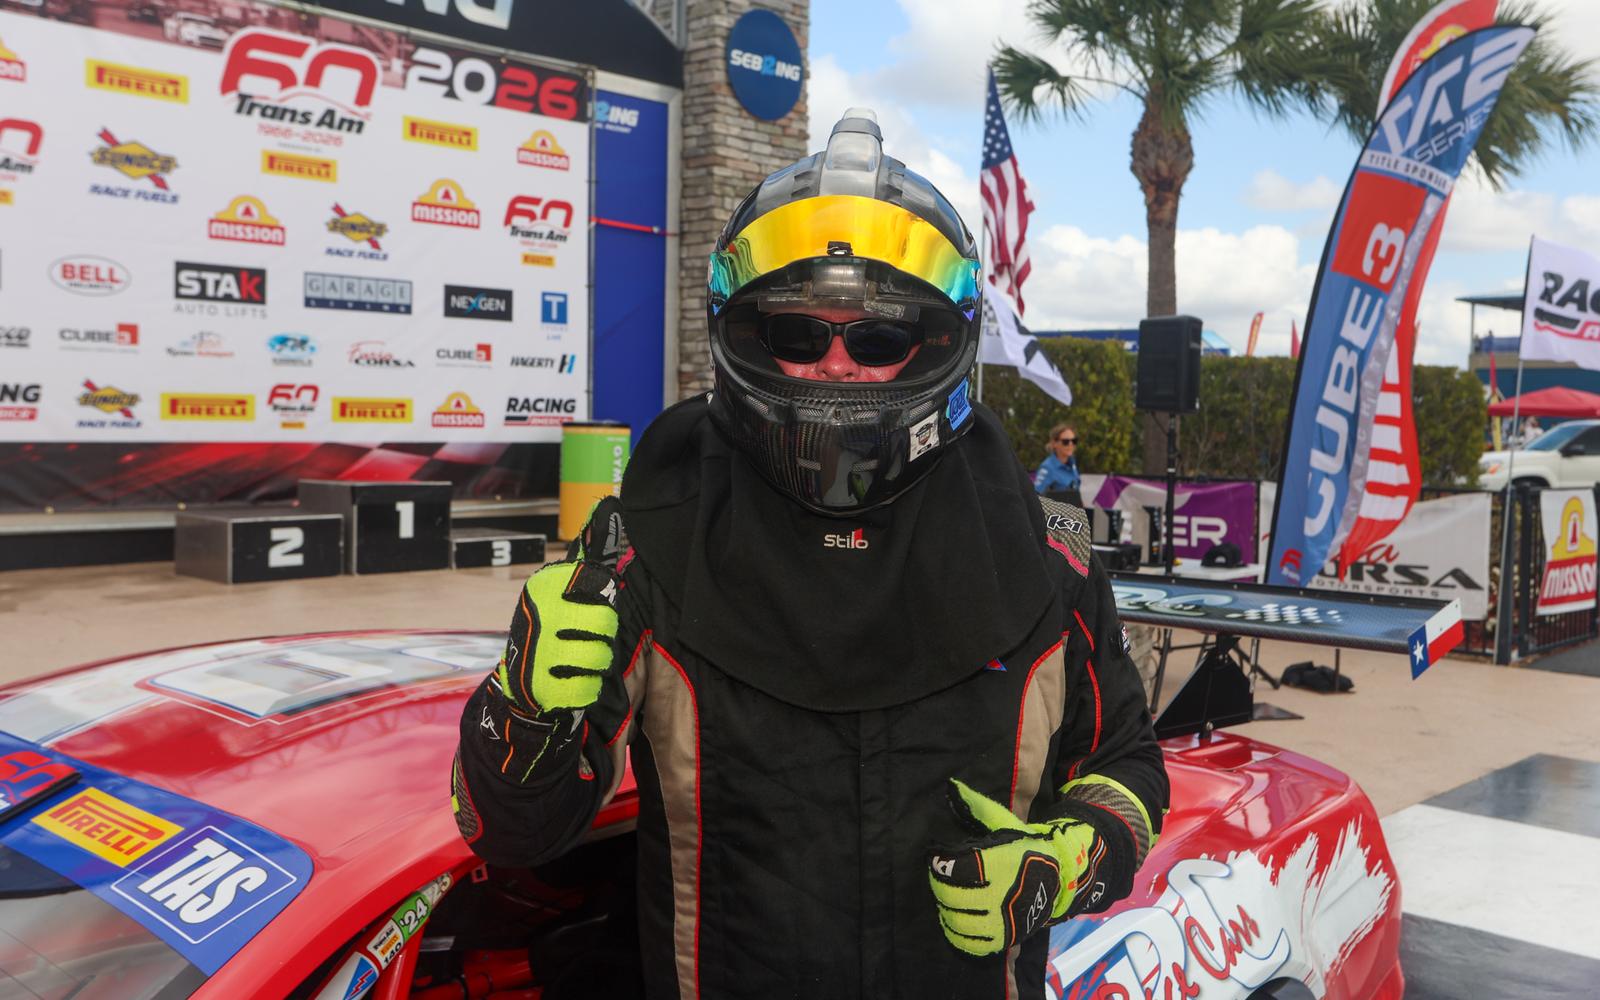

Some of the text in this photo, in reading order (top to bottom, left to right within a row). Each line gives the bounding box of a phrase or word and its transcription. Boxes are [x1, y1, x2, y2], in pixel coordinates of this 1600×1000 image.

[96, 65, 181, 98] PIRELLI
[406, 47, 578, 120] 2026
[234, 94, 365, 134] Trans Am
[409, 121, 474, 147] PIRELLI
[267, 154, 332, 179] PIRELLI
[510, 225, 568, 243] Trans Am
[60, 263, 122, 284] BELL
[308, 276, 407, 300] GARAGE
[174, 303, 267, 320] AUTO LIFTS
[510, 355, 554, 371] HAGERTY
[170, 397, 247, 417] PIRELLI
[339, 402, 406, 419] PIRELLI
[506, 397, 576, 414] RACING
[396, 501, 414, 538] 1
[1047, 514, 1083, 534] K1
[268, 527, 304, 568] 2
[824, 530, 869, 549] Stilo
[492, 540, 511, 566] 3
[48, 795, 165, 857] PIRELLI
[137, 837, 268, 924] TAS
